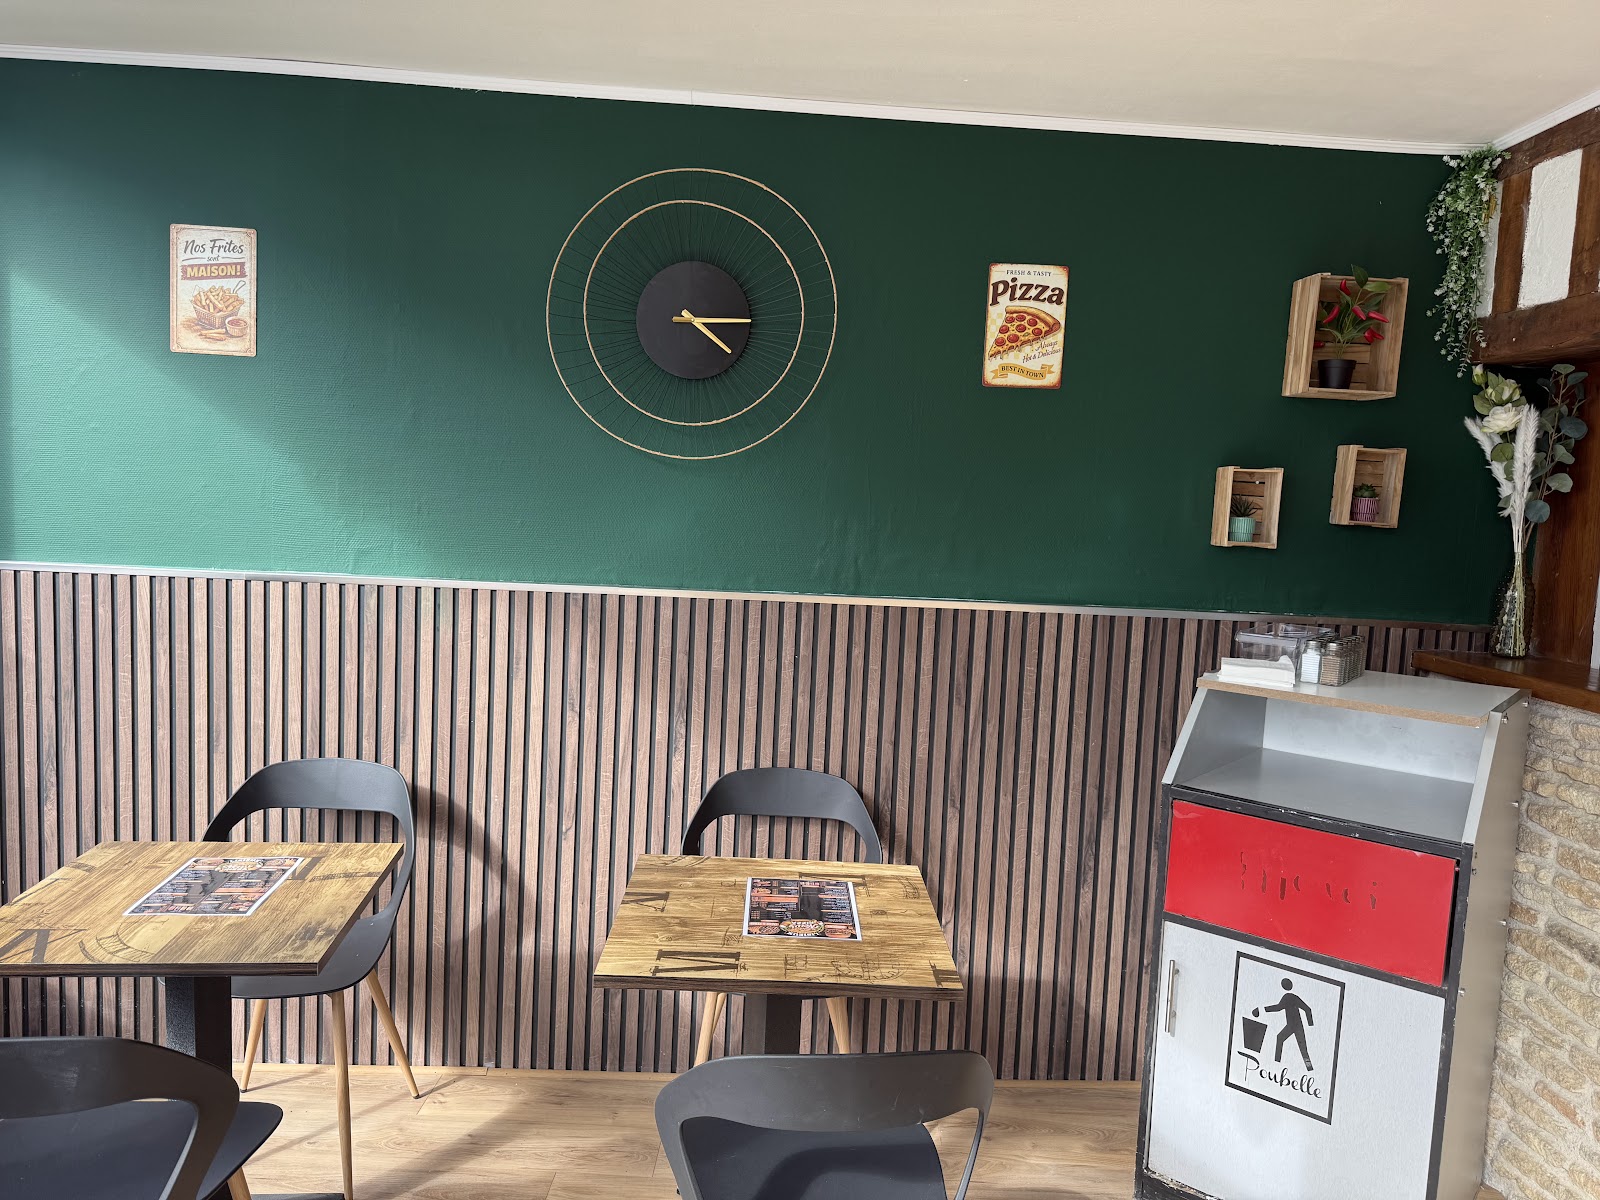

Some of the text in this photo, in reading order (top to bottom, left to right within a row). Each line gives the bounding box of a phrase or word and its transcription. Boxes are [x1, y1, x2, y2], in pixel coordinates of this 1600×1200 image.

[184, 239, 243, 255] Nos Frites
[187, 265, 240, 277] MAISON!
[990, 277, 1064, 306] Pizza
[1025, 370, 1044, 378] TOWN
[1237, 1050, 1321, 1098] Poubelle
